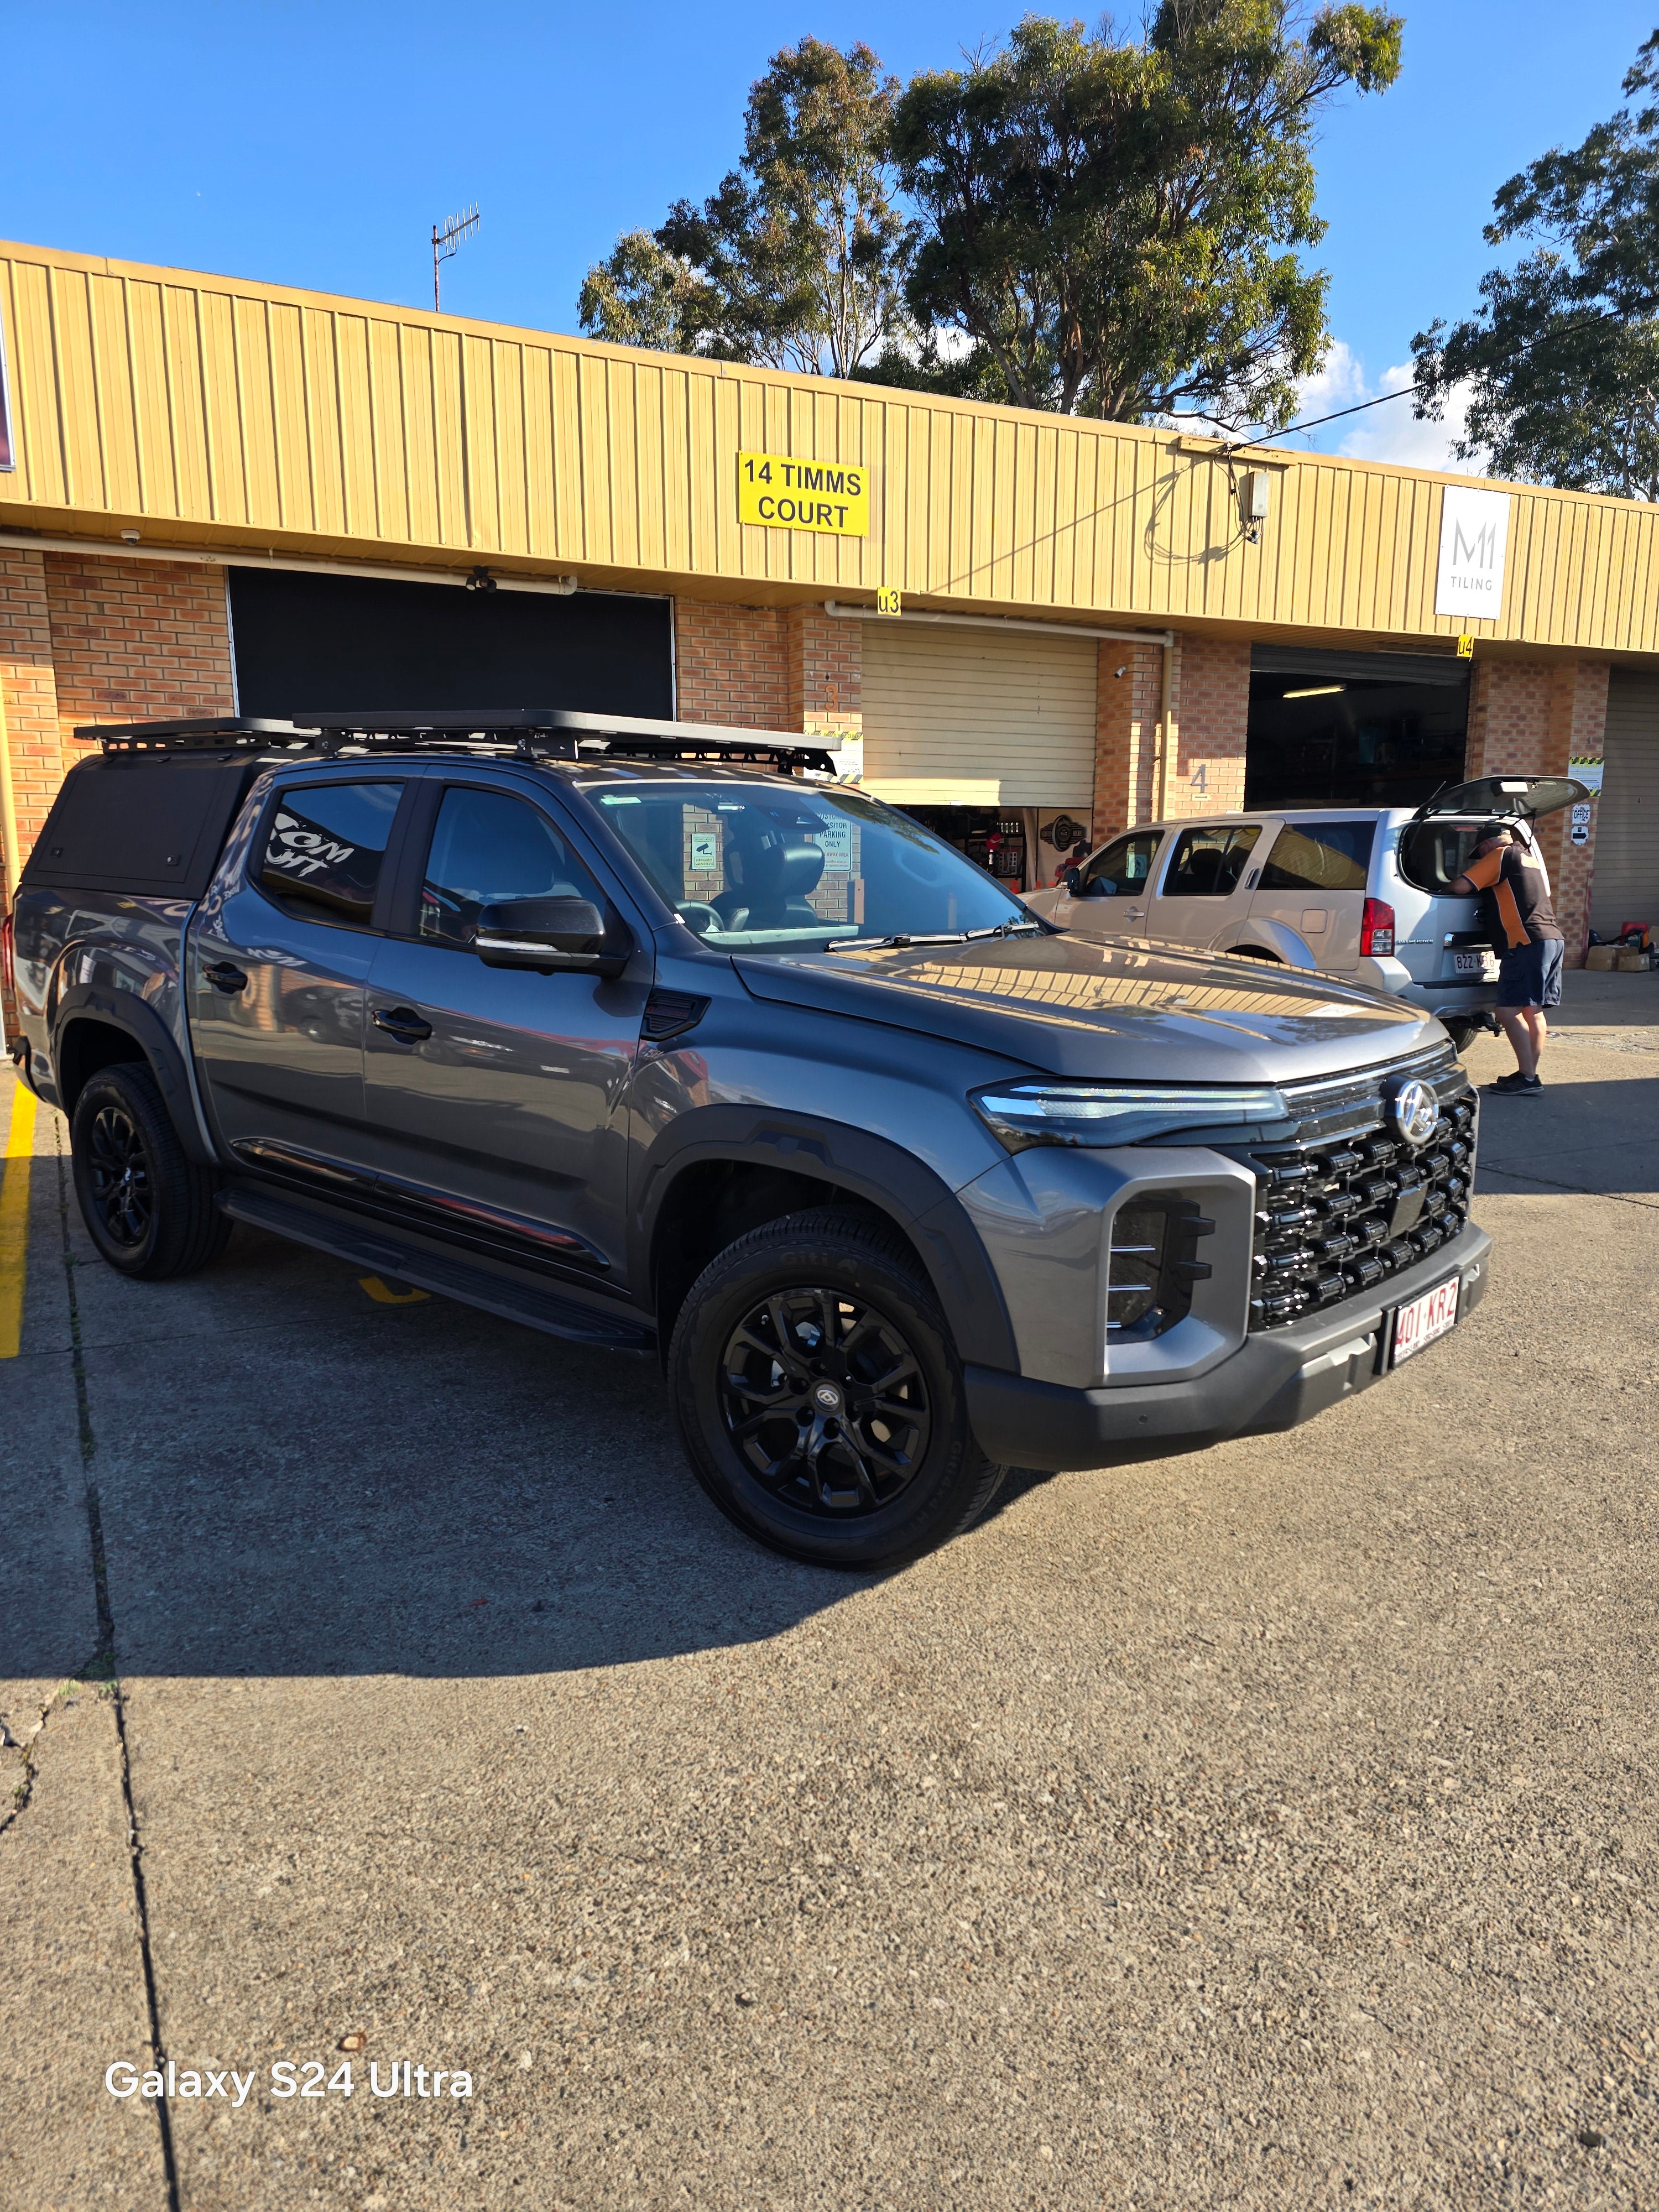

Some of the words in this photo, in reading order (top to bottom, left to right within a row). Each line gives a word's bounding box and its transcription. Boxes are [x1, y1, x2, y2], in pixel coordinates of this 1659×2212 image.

[745, 459, 772, 484] 14
[780, 463, 861, 495] TIMMS
[759, 496, 848, 528] COURT
[1451, 576, 1492, 591] TILING
[879, 591, 899, 613] u3
[1458, 639, 1472, 655] u4
[825, 685, 838, 712] 3
[1191, 764, 1209, 793] 4
[1574, 810, 1589, 819] OFFICE
[780, 1251, 828, 1266] Giti
